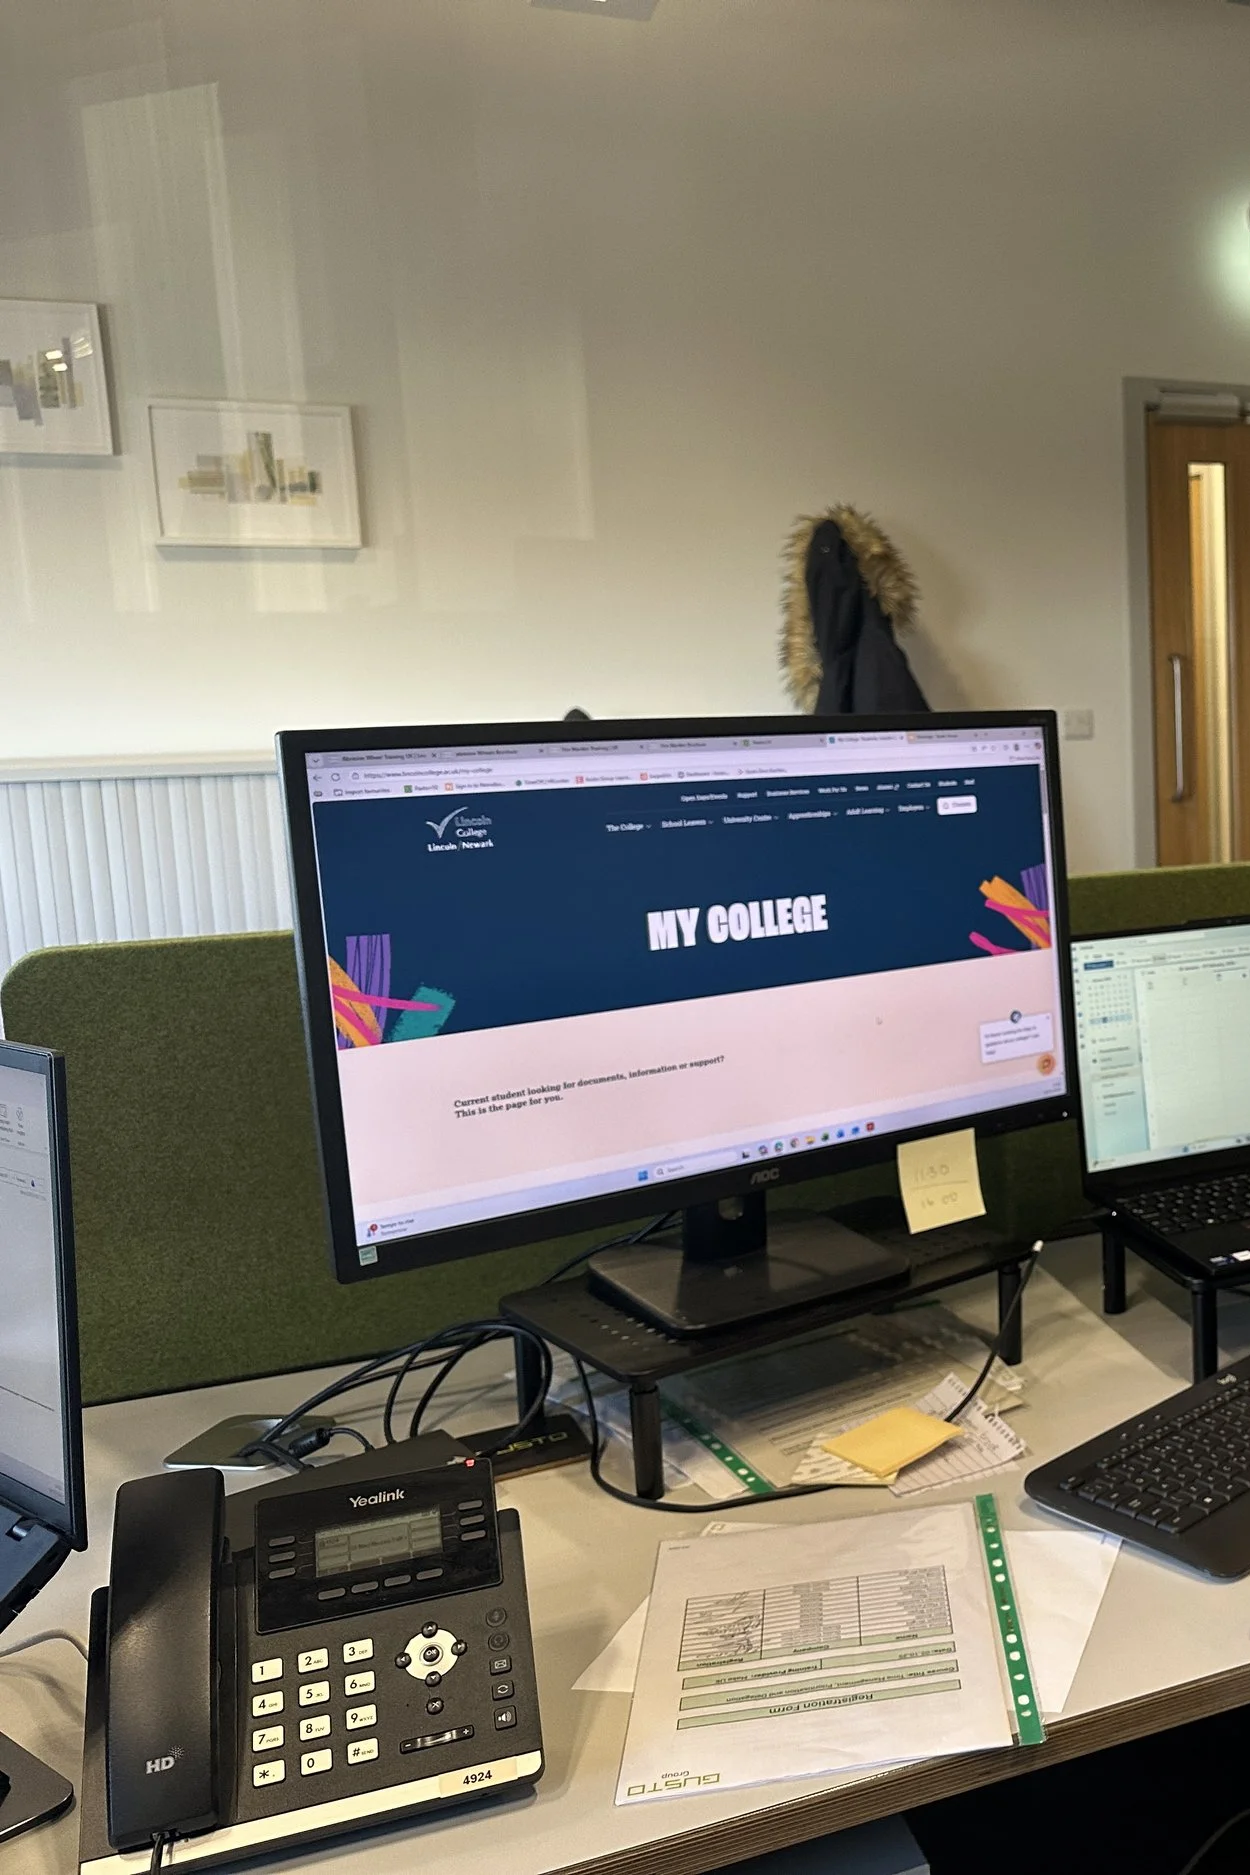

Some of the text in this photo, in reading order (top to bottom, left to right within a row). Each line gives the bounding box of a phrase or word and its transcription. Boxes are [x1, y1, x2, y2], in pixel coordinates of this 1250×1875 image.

[455, 815, 492, 827] Lincoln
[456, 828, 487, 838] College
[427, 839, 494, 852] Lincoln Newark
[647, 894, 829, 951] MY COLLEGE
[454, 1055, 725, 1109] Current student looking for documents, information or support?
[455, 1094, 564, 1119] This is the page for you.
[349, 1488, 405, 1508] Yealink
[348, 1646, 356, 1657] 3
[304, 1656, 312, 1666] 2
[697, 1657, 744, 1667] Registration
[259, 1665, 264, 1676] 1
[751, 1669, 786, 1680] Provider:
[787, 1664, 818, 1674] Training
[926, 1666, 955, 1674] Course
[349, 1679, 357, 1689] 6
[306, 1689, 313, 1699] 5
[258, 1699, 266, 1709] 4
[769, 1693, 874, 1715] Registration Form
[350, 1713, 358, 1723] 9
[306, 1723, 313, 1734] 8
[258, 1734, 266, 1745] 7
[145, 1755, 175, 1775] HD
[306, 1758, 315, 1768] 0
[462, 1769, 492, 1785] 4924
[661, 1770, 690, 1779] Group
[627, 1773, 720, 1797] GUSTO
